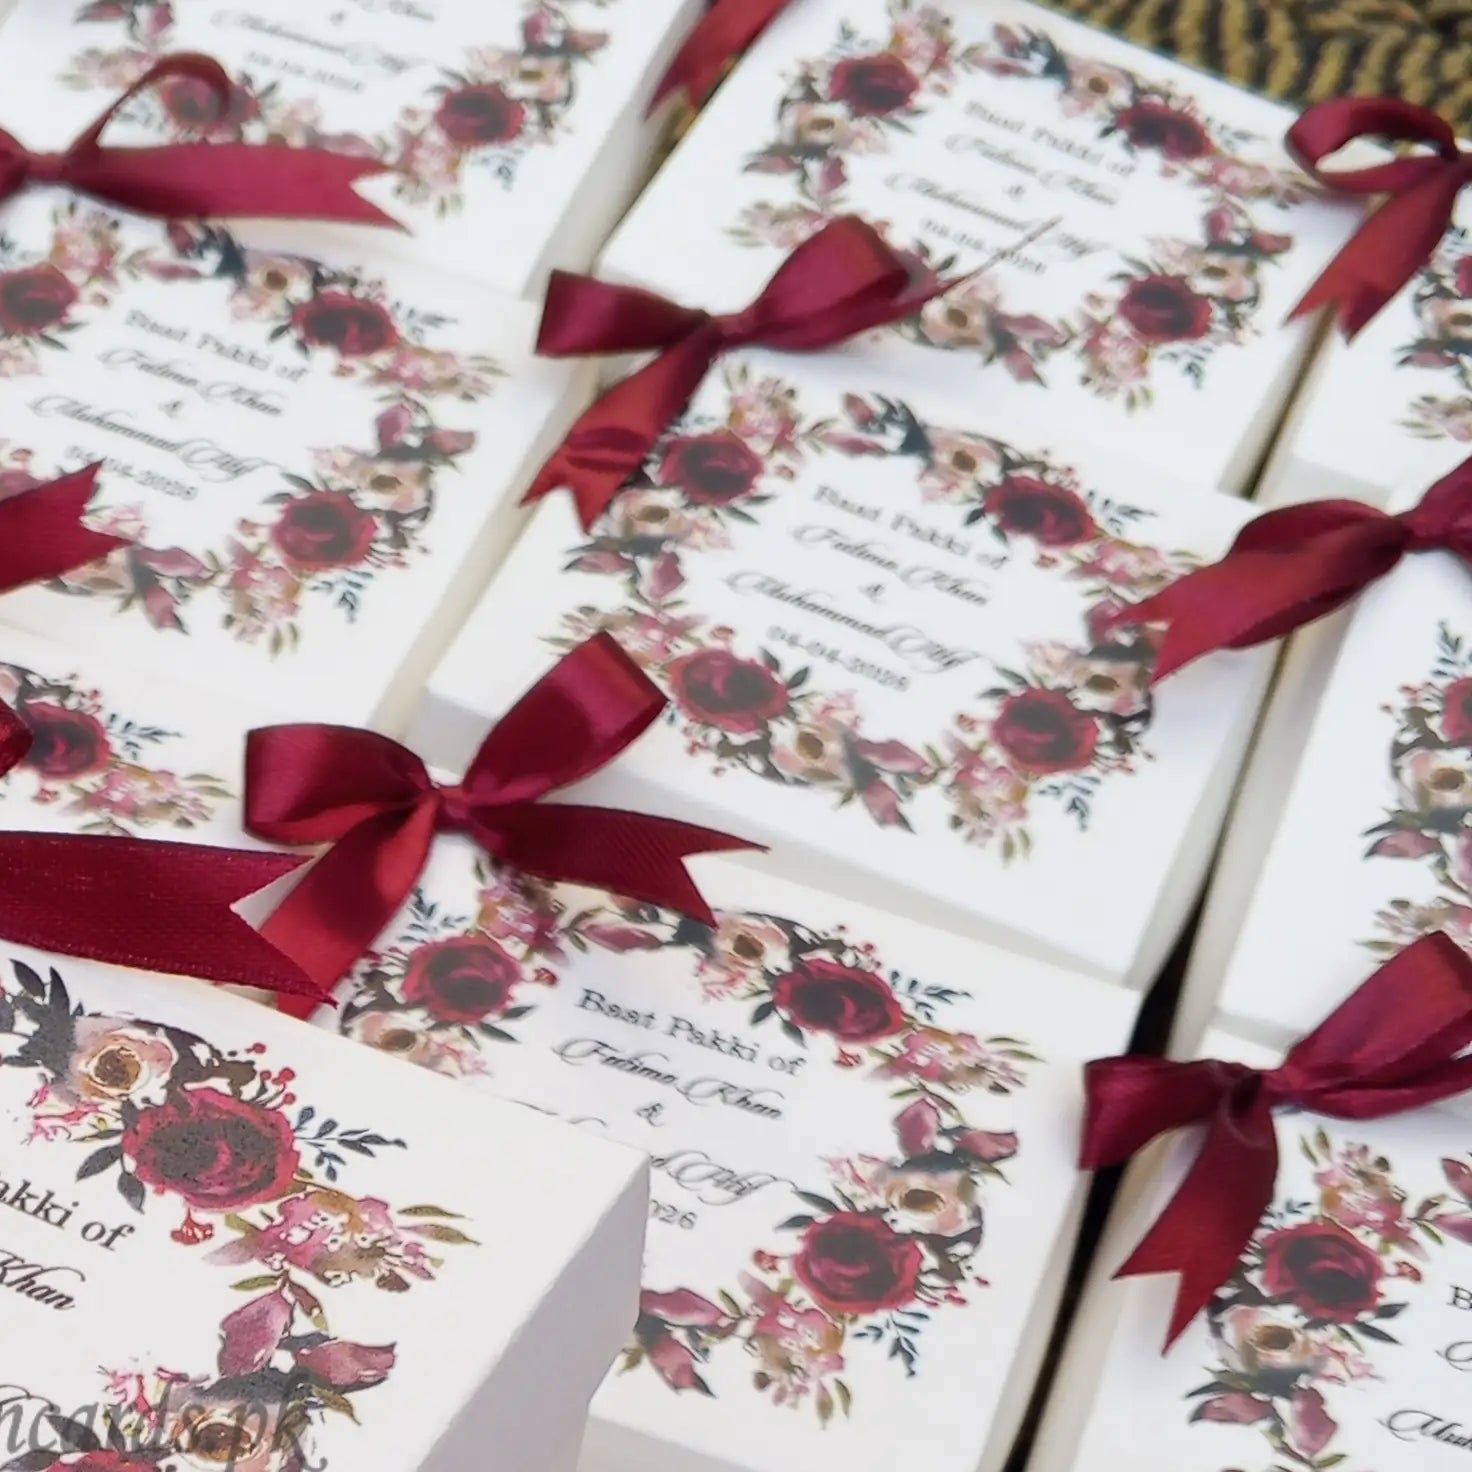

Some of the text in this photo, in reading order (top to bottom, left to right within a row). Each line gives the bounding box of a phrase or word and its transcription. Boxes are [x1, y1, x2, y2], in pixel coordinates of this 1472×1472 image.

[577, 987, 807, 1077] Baat Pakki of
[81, 1223, 136, 1251] of
